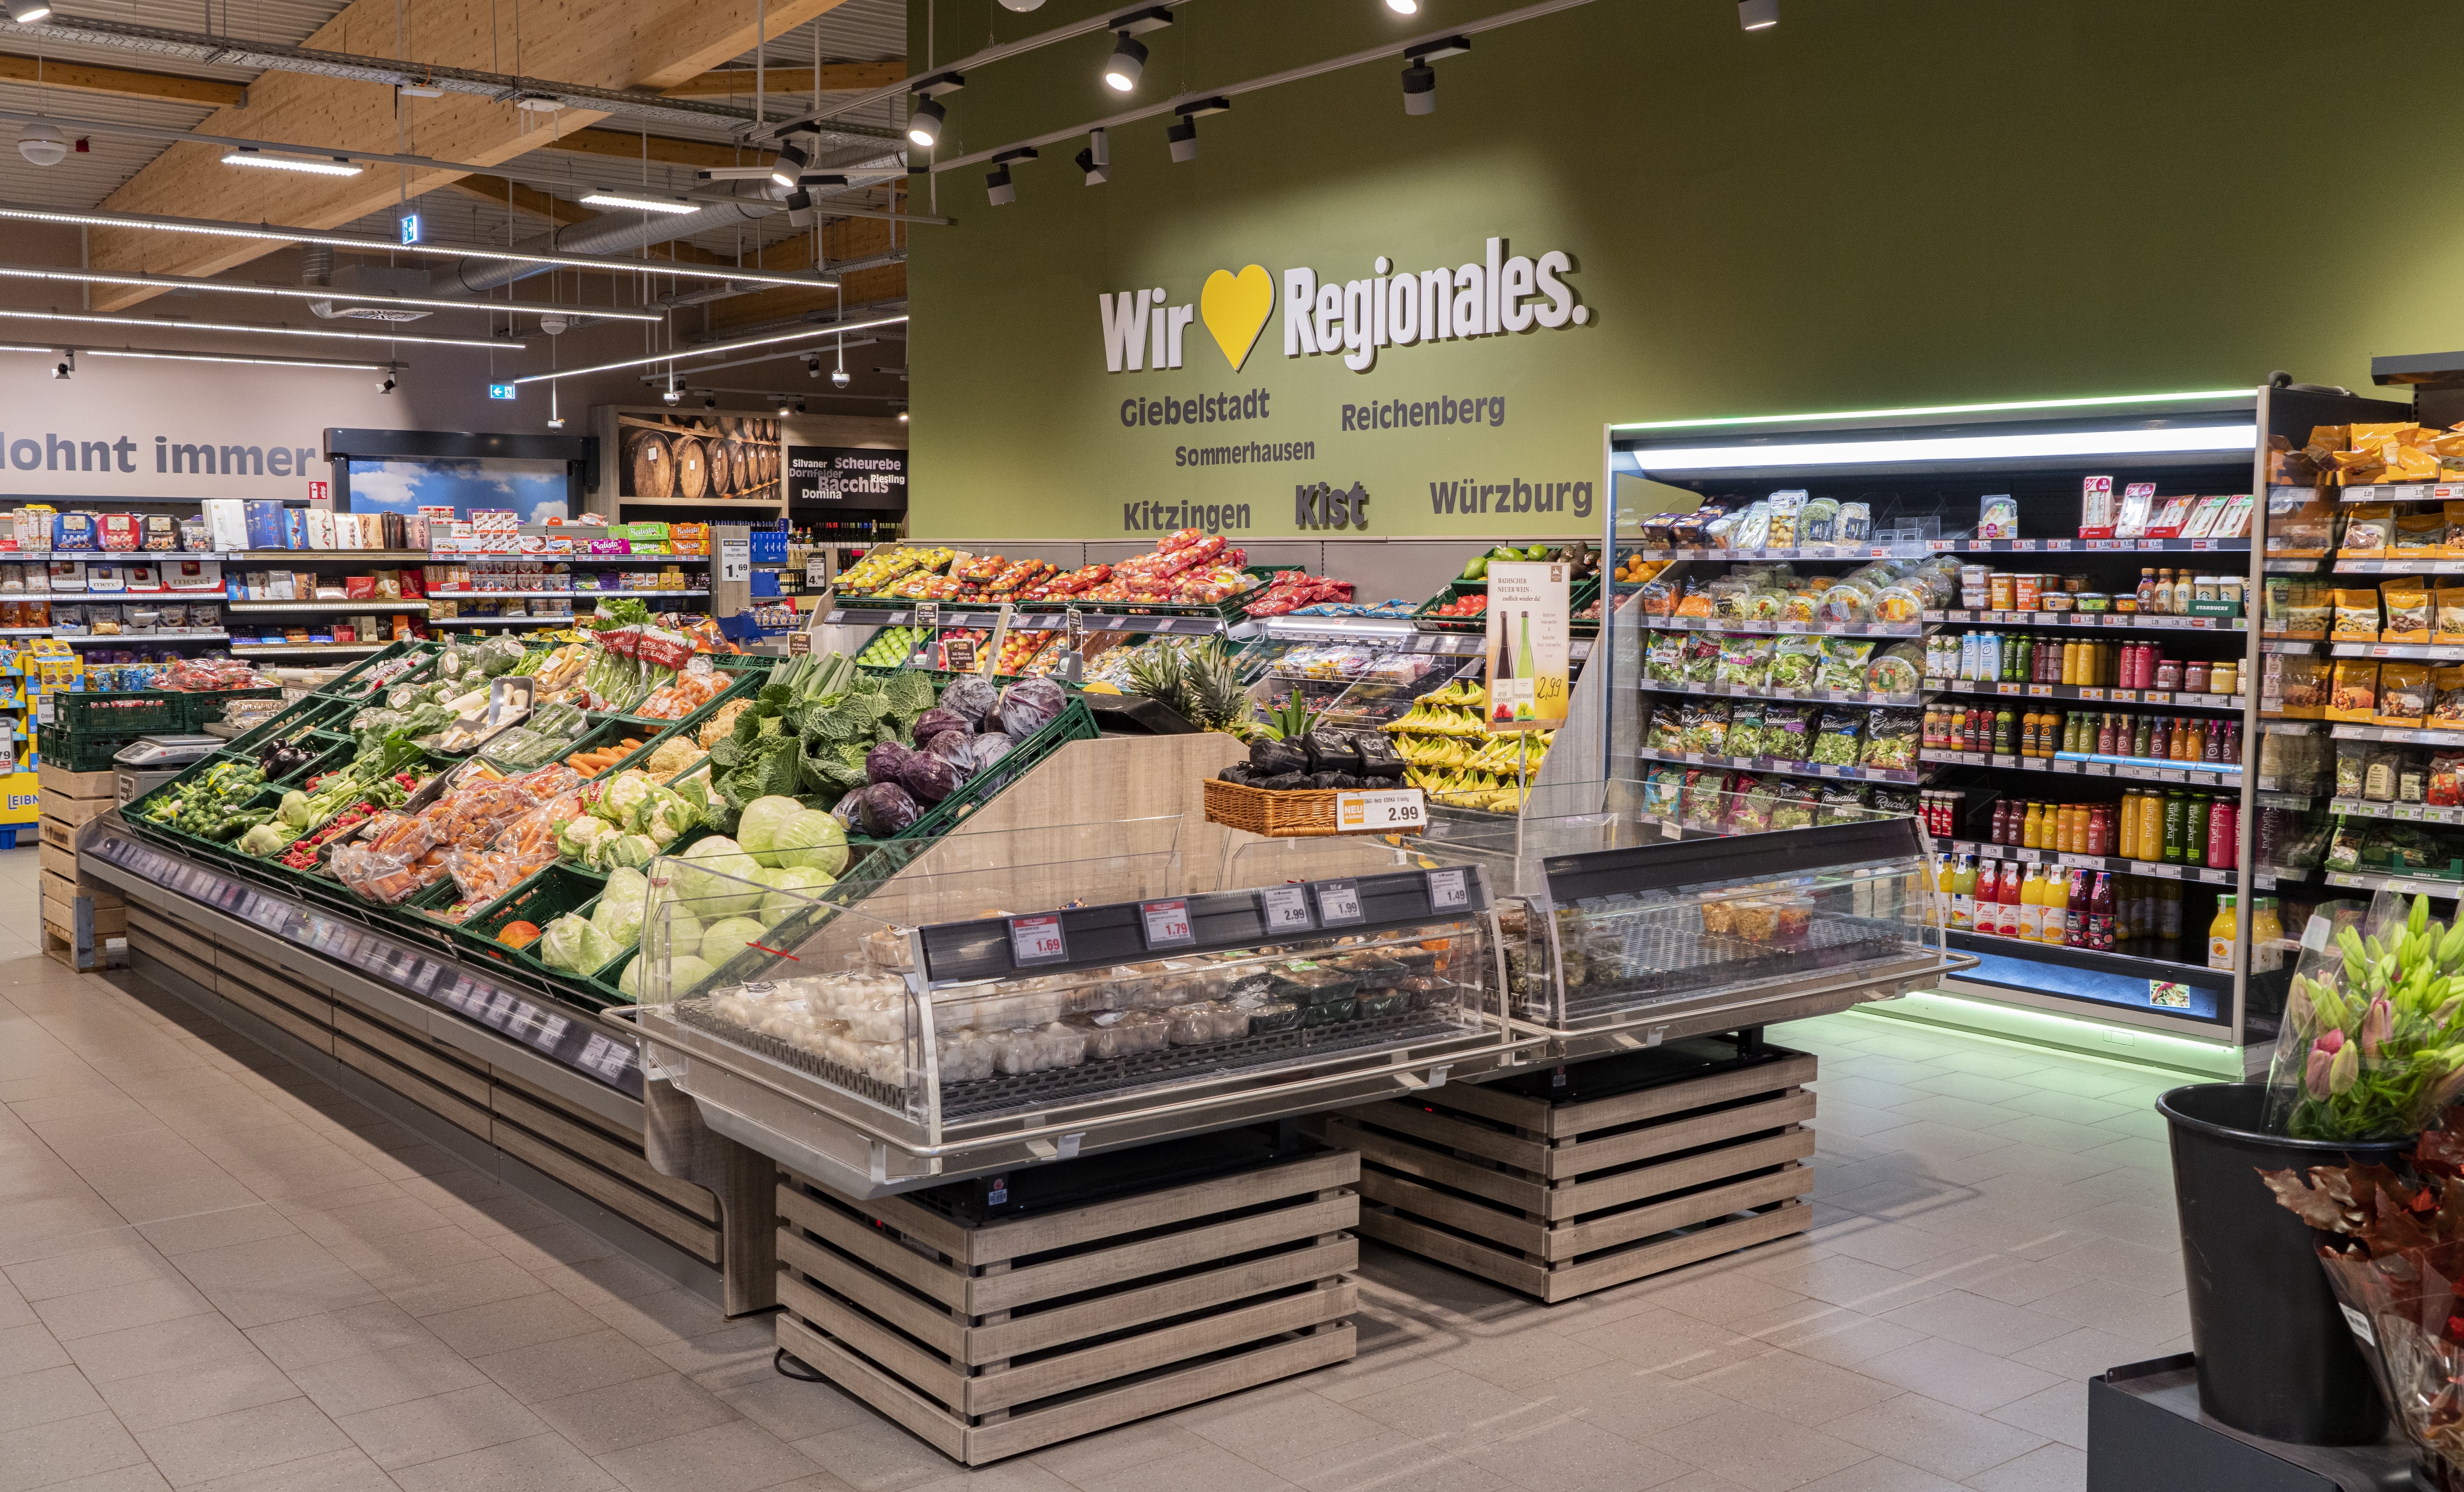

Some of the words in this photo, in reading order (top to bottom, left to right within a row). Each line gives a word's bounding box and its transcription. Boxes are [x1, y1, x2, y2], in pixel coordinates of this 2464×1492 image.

[1100, 288, 1193, 372] Wir
[1284, 237, 1589, 371] Regionales.
[1121, 388, 1269, 427] Giebelstadt
[1342, 396, 1505, 431] Reichenberg
[155, 436, 315, 476] immer
[1176, 439, 1314, 467] Sommerhausen
[793, 459, 827, 468] Silvaner
[835, 457, 901, 470] Scheurebe
[789, 469, 843, 478] Dornfelder
[871, 475, 905, 485] Riesling
[819, 476, 889, 493] Bacchus
[802, 489, 842, 499] Domina
[1430, 478, 1592, 517] Würzburg
[1296, 482, 1366, 525] Kist
[1124, 500, 1250, 534] Kitzingen
[629, 527, 655, 535] Balisto
[677, 526, 699, 535] Balisto
[677, 542, 699, 550] Balisto
[726, 564, 748, 577] 1.69
[809, 575, 823, 584] 4.99
[1537, 677, 1562, 701] 2,99
[1764, 713, 1803, 725] Salatmix
[1344, 805, 1363, 814] NEU
[1876, 796, 1910, 810] Rucola
[1388, 806, 1418, 821] 2.99
[1447, 890, 1465, 901] 1.49
[1284, 909, 1304, 920] 2.99
[1338, 902, 1357, 914] 1.99
[1165, 923, 1188, 935] 1.79
[1036, 938, 1060, 951] 1.69
